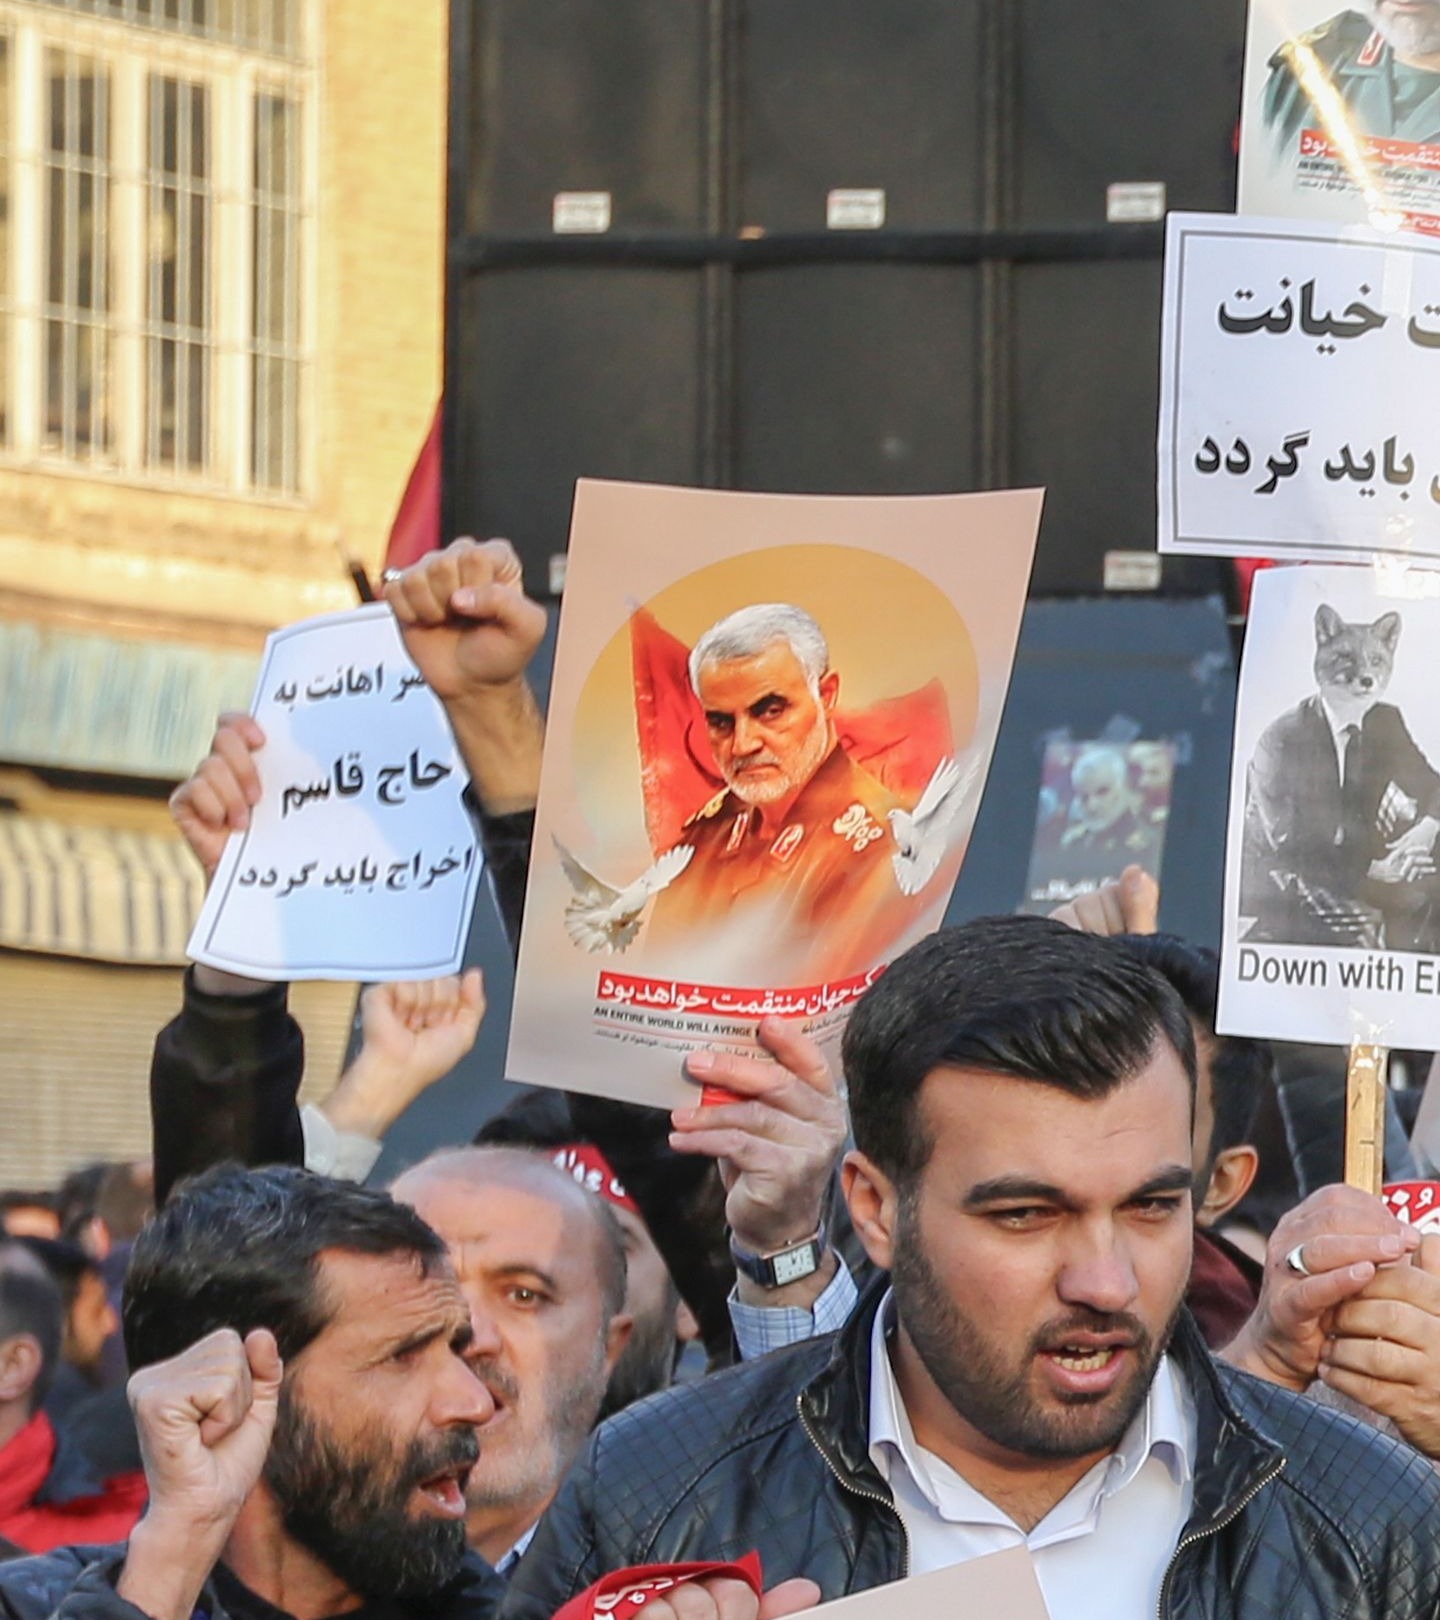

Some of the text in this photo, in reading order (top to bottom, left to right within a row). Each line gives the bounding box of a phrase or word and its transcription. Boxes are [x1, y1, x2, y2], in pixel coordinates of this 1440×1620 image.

[1217, 277, 1388, 355] خیانت
[1194, 428, 1312, 495] گردد
[1322, 434, 1416, 502] باید
[273, 681, 298, 712] به
[306, 663, 384, 701] اهانت
[281, 749, 452, 819] حاج قاسم
[322, 854, 378, 895] باید
[385, 845, 473, 891] اخراج
[1237, 947, 1328, 988] Down
[1338, 954, 1405, 993] with
[711, 991, 807, 1017] منتقمت
[806, 983, 852, 1014] جهان
[593, 1006, 752, 1038] AN ENTIRE WORLD WILL AVENGE
